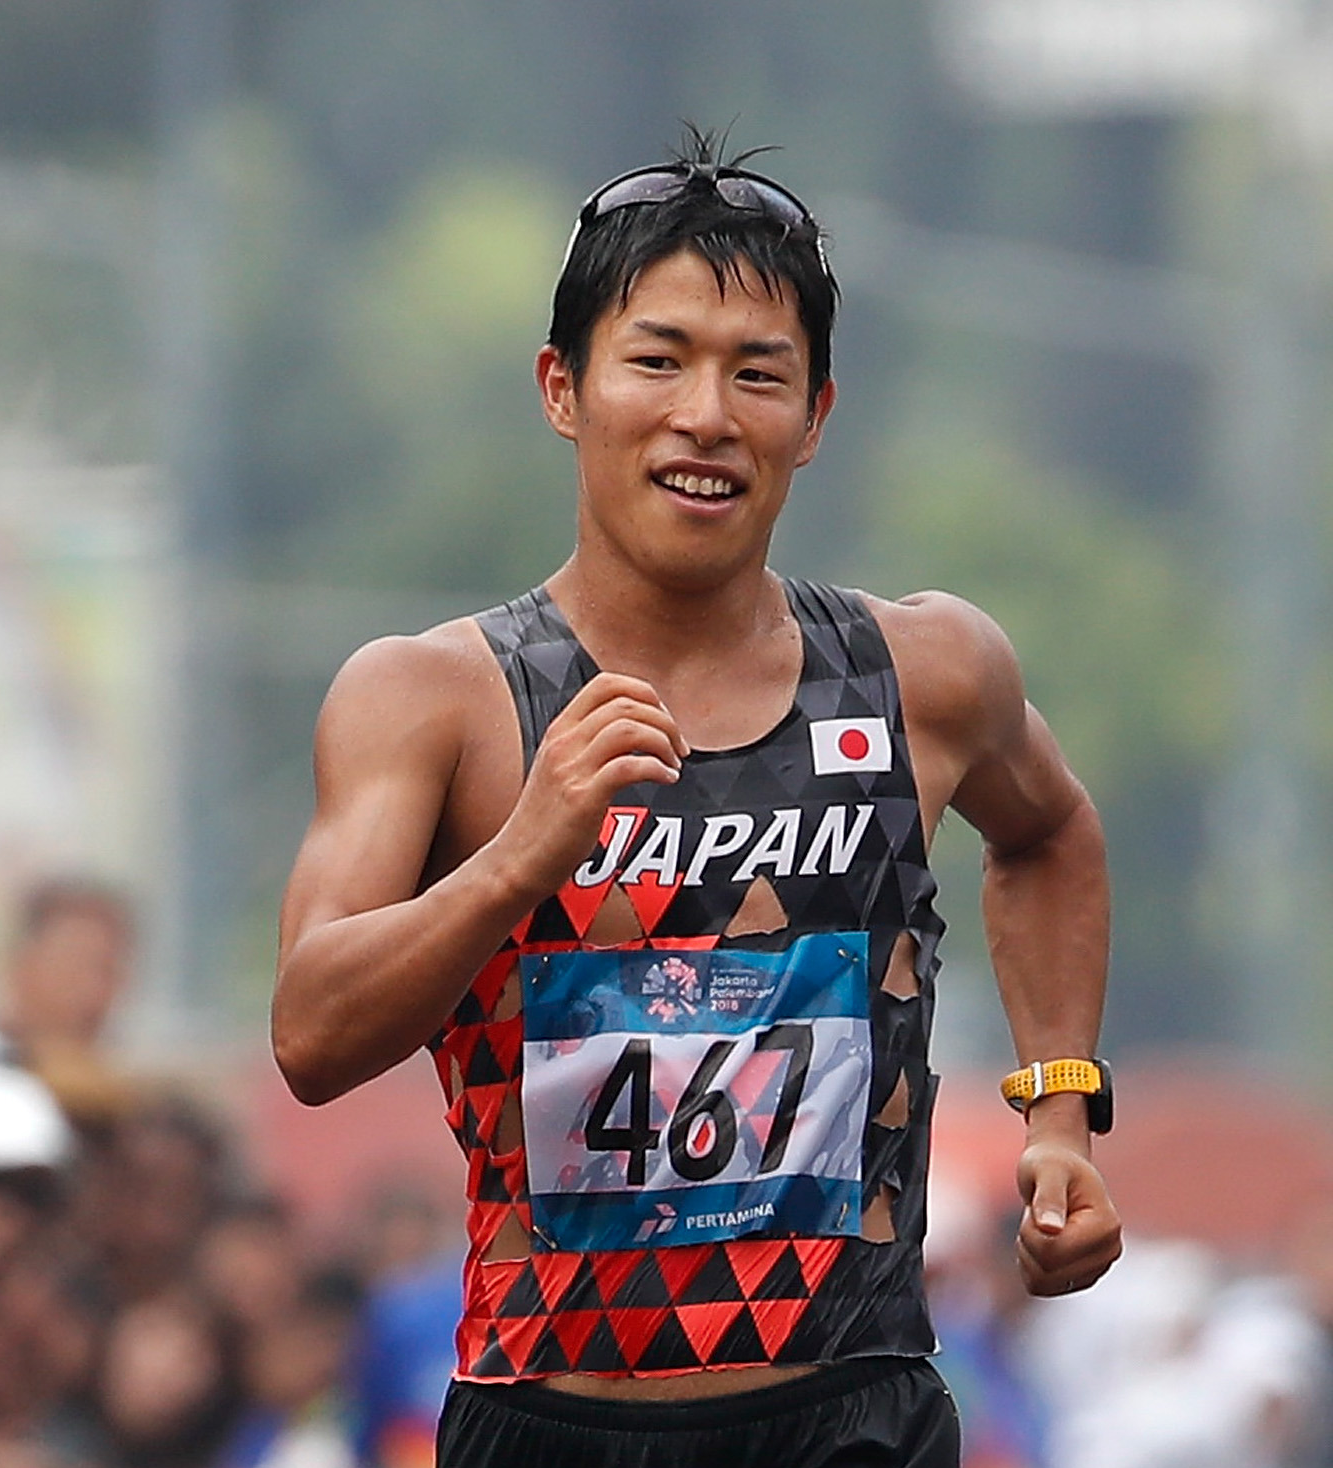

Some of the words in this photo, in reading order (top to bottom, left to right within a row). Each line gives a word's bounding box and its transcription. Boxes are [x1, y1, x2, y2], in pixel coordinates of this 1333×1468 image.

[574, 804, 874, 887] JAPAN
[585, 1024, 814, 1186] 467
[686, 1202, 775, 1229] PERTAMINA
